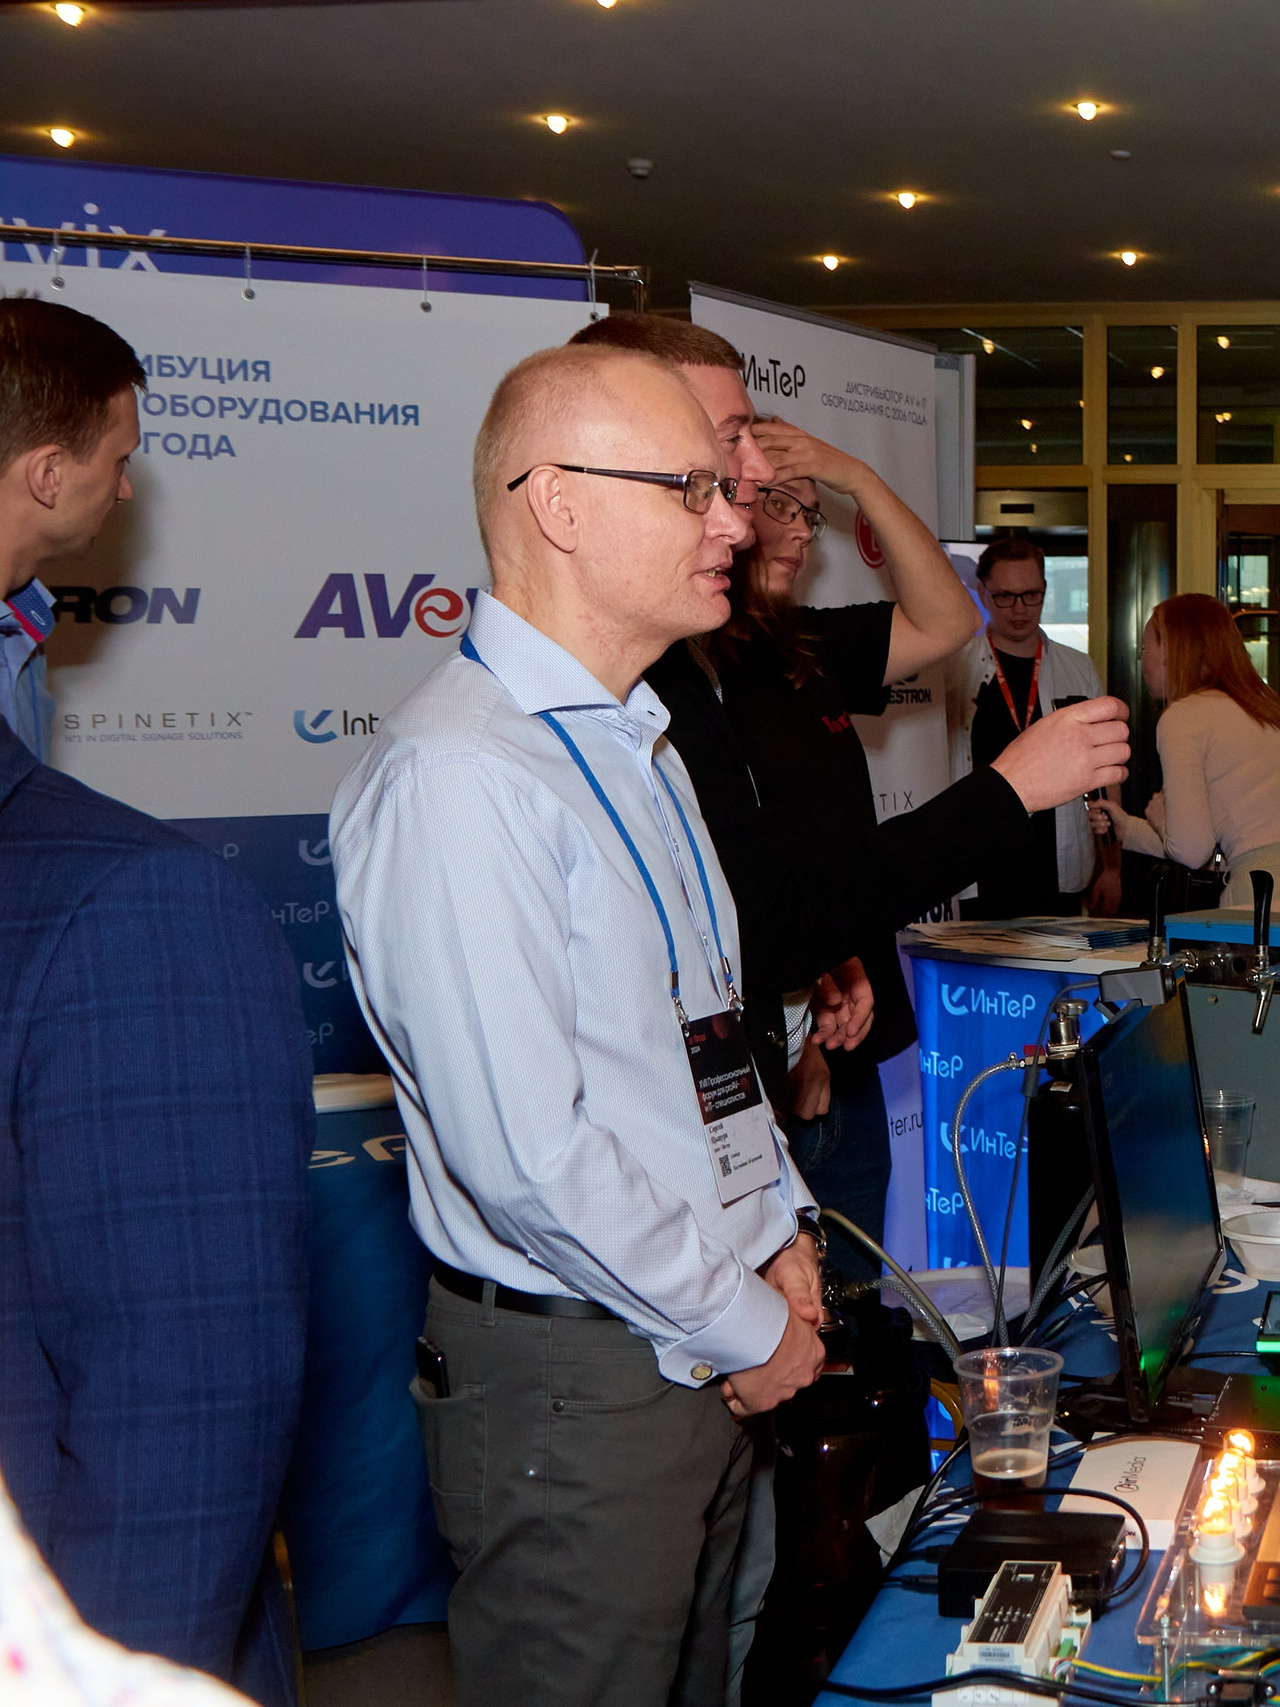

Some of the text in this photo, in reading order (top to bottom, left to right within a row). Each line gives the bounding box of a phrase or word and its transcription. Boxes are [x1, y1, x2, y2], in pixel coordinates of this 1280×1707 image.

[741, 352, 806, 398] ИнТеР
[845, 381, 903, 403] ДИСТРИБЬЮТОР
[142, 393, 420, 426] ОБОРУДОВАНИЯ
[821, 393, 884, 416] ОБОРУДОВАНИЯ
[891, 408, 907, 422] 2006
[908, 411, 927, 425] ГОДА
[142, 432, 237, 460] ГОДА
[100, 733, 138, 743] DIGITAL
[141, 732, 184, 742] SIGNAGE
[188, 731, 243, 741] SOLUTIONS
[971, 988, 1036, 1018] ИнТеР
[1114, 1456, 1147, 1493] AirMedia
